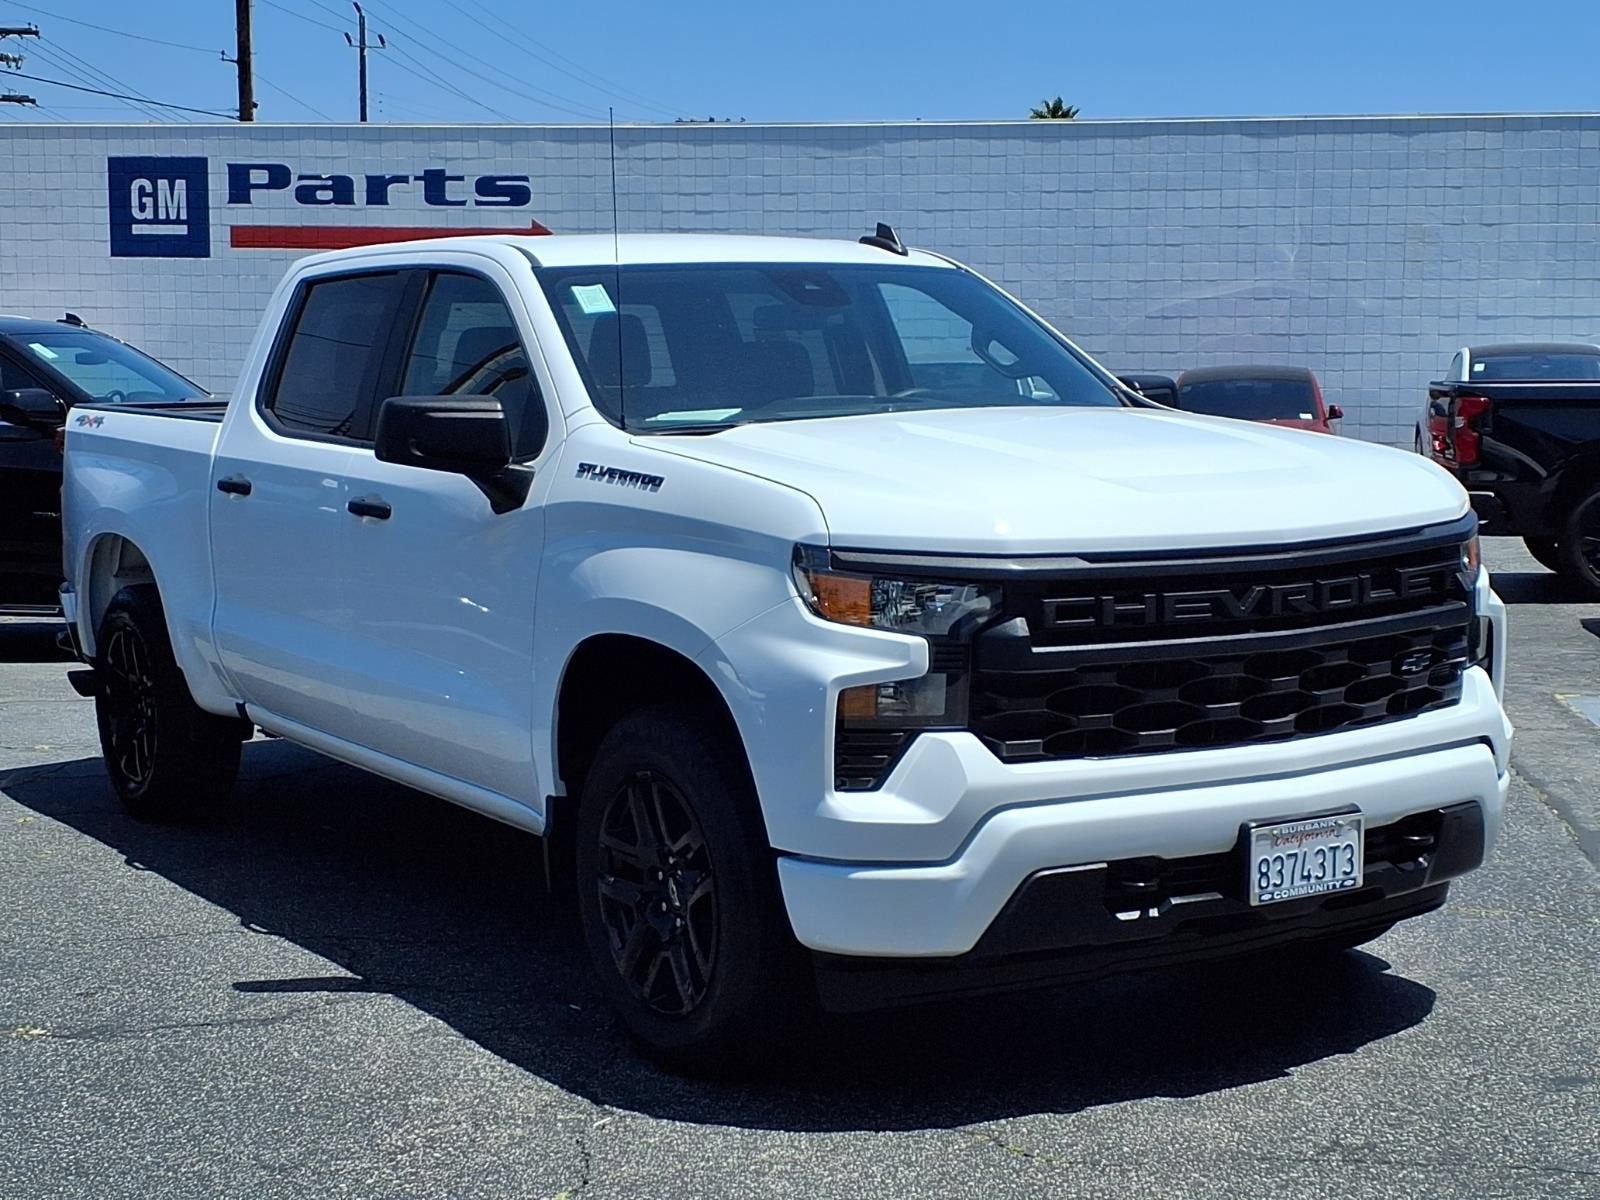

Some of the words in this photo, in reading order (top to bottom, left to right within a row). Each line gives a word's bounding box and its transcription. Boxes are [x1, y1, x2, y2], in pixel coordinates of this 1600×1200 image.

[130, 178, 187, 220] GM
[226, 162, 533, 208] Parts
[576, 461, 666, 489] SILVERADO
[1281, 819, 1337, 835] BURBANK
[1257, 842, 1355, 890] 83743T3
[1272, 880, 1342, 900] COMMUNITY
